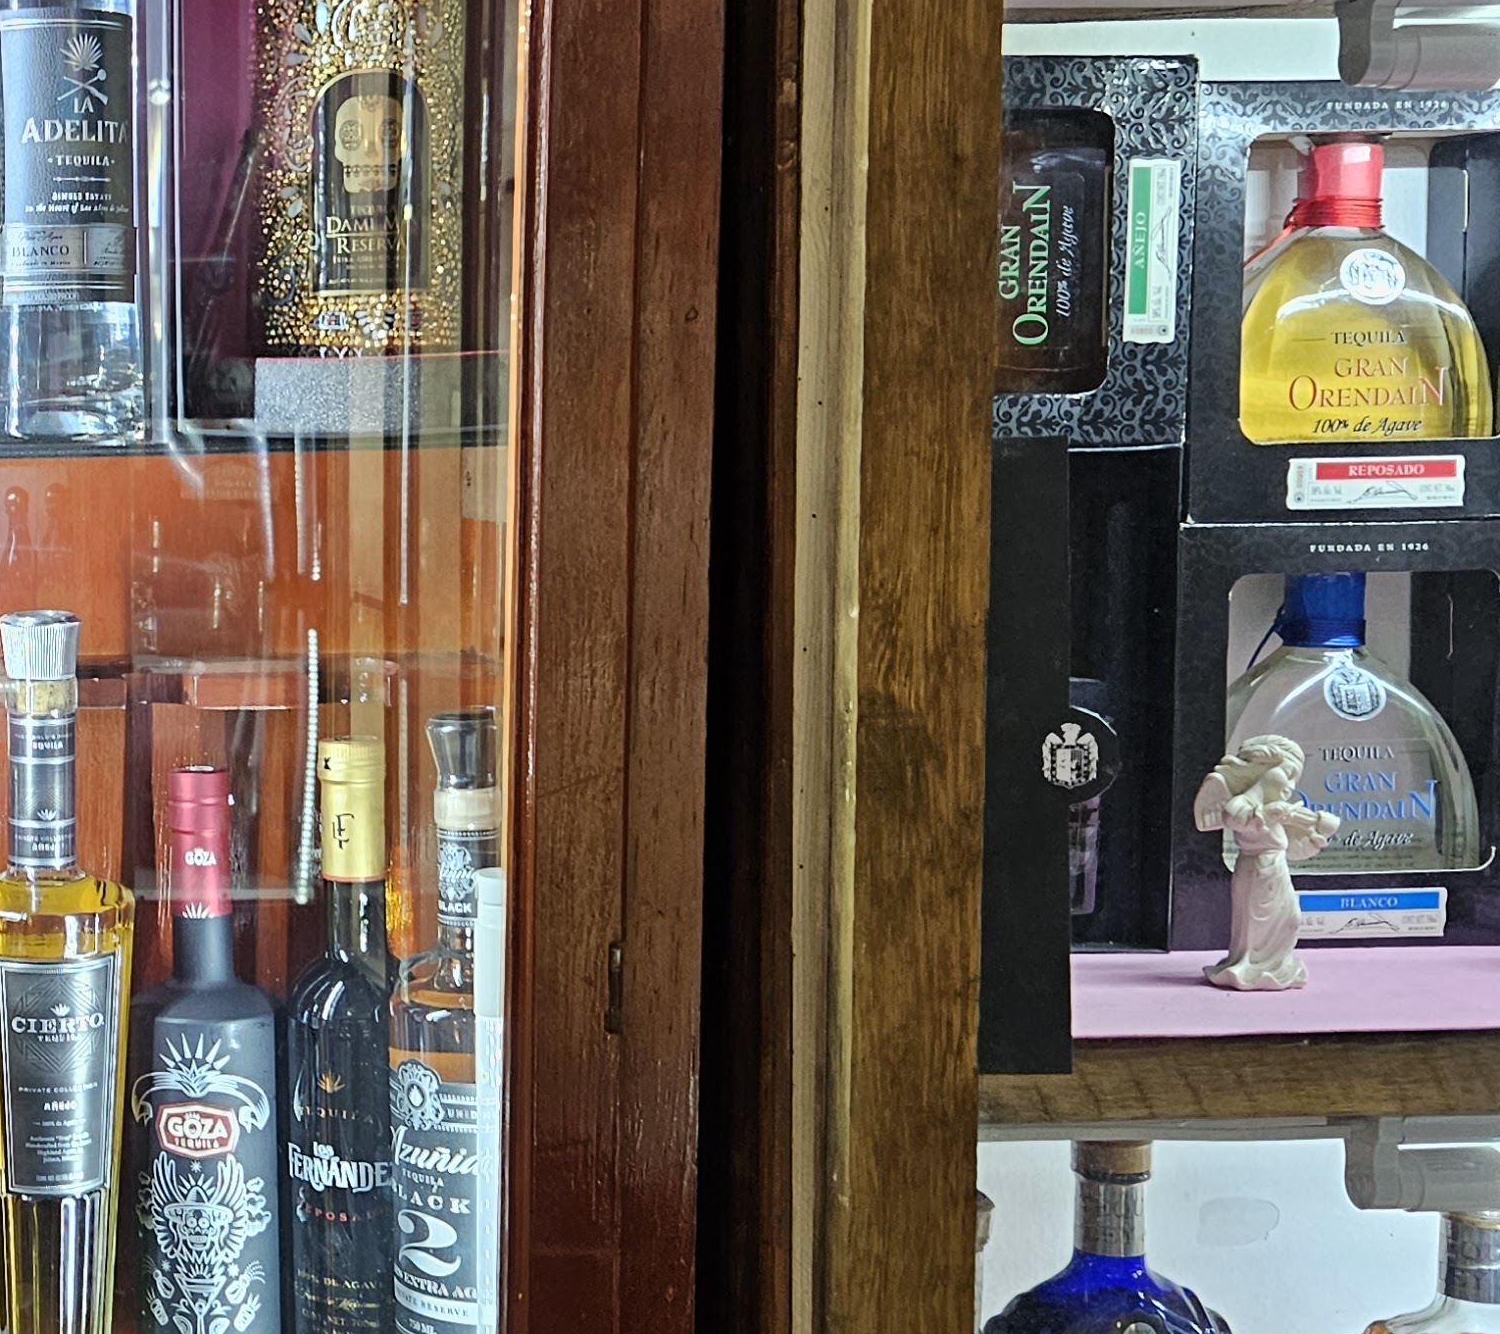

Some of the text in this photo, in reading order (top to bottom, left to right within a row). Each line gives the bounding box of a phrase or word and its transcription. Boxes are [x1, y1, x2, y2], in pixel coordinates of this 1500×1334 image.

[73, 96, 94, 114] LA
[1326, 101, 1389, 110] FUNDADA
[1395, 100, 1413, 109] EN
[20, 117, 129, 145] ADELITA
[55, 154, 110, 167] TEQUILA
[1131, 211, 1148, 269] AÑEJO
[12, 244, 70, 258] BLANCO
[998, 223, 1022, 300] GRAN
[1012, 180, 1051, 346] ORENDAIN
[1331, 329, 1406, 348] TEQUILA
[1334, 356, 1410, 379] GRAN
[1288, 365, 1451, 412] ORENDAIN
[1312, 416, 1423, 437] 100% de Agave
[1348, 464, 1425, 477] REPOSADO
[1309, 543, 1372, 554] FUNDADA
[1377, 543, 1395, 552] EN
[1319, 745, 1395, 763] TEQUILA
[1324, 771, 1398, 794] GRAN
[1343, 828, 1362, 847] de
[1340, 896, 1399, 910] BLANCO
[11, 1012, 105, 1035] CIERTO
[18, 1086, 51, 1094] PRIVATE
[173, 1138, 221, 1150] TEQUILA
[287, 1141, 393, 1193] FERNÁNDE
[398, 1208, 462, 1277] 2
[403, 1273, 450, 1299] EXTRA
